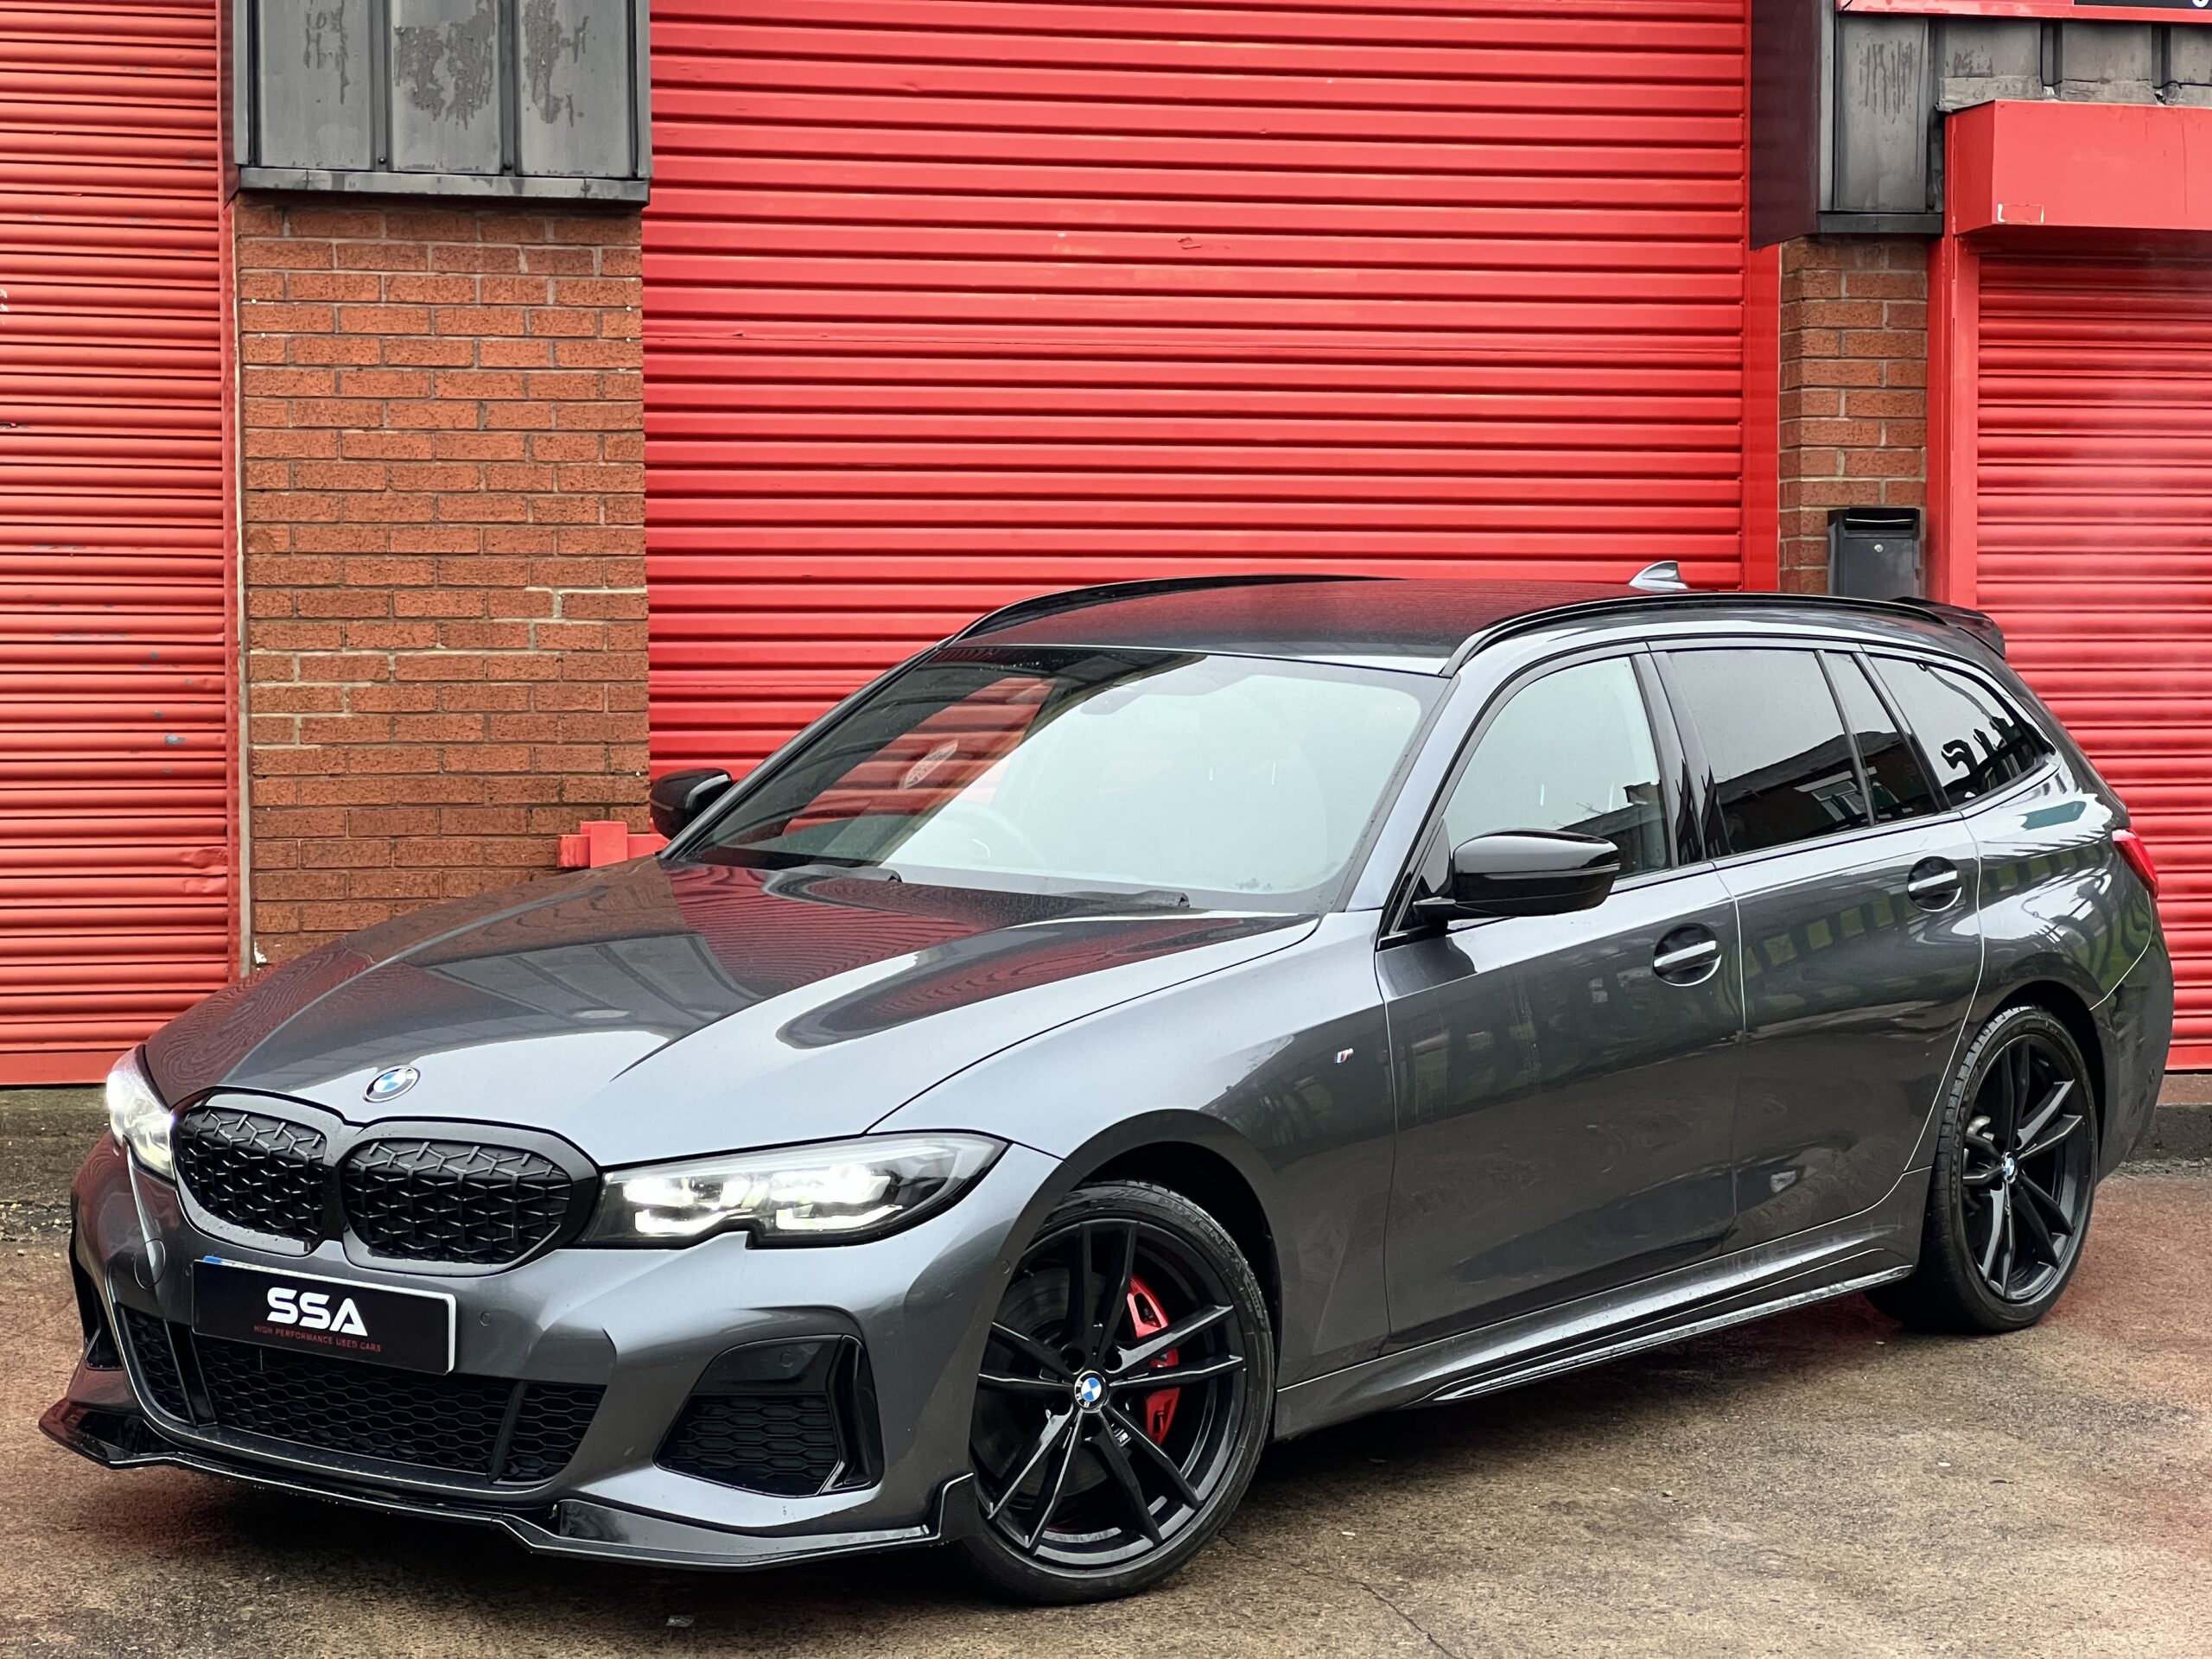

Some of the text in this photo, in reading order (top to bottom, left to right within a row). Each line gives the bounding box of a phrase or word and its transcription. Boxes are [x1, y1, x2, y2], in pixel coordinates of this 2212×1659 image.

[266, 1287, 368, 1337] SSA
[254, 1325, 382, 1352] HIGH PERFORMANCE USED CARS
